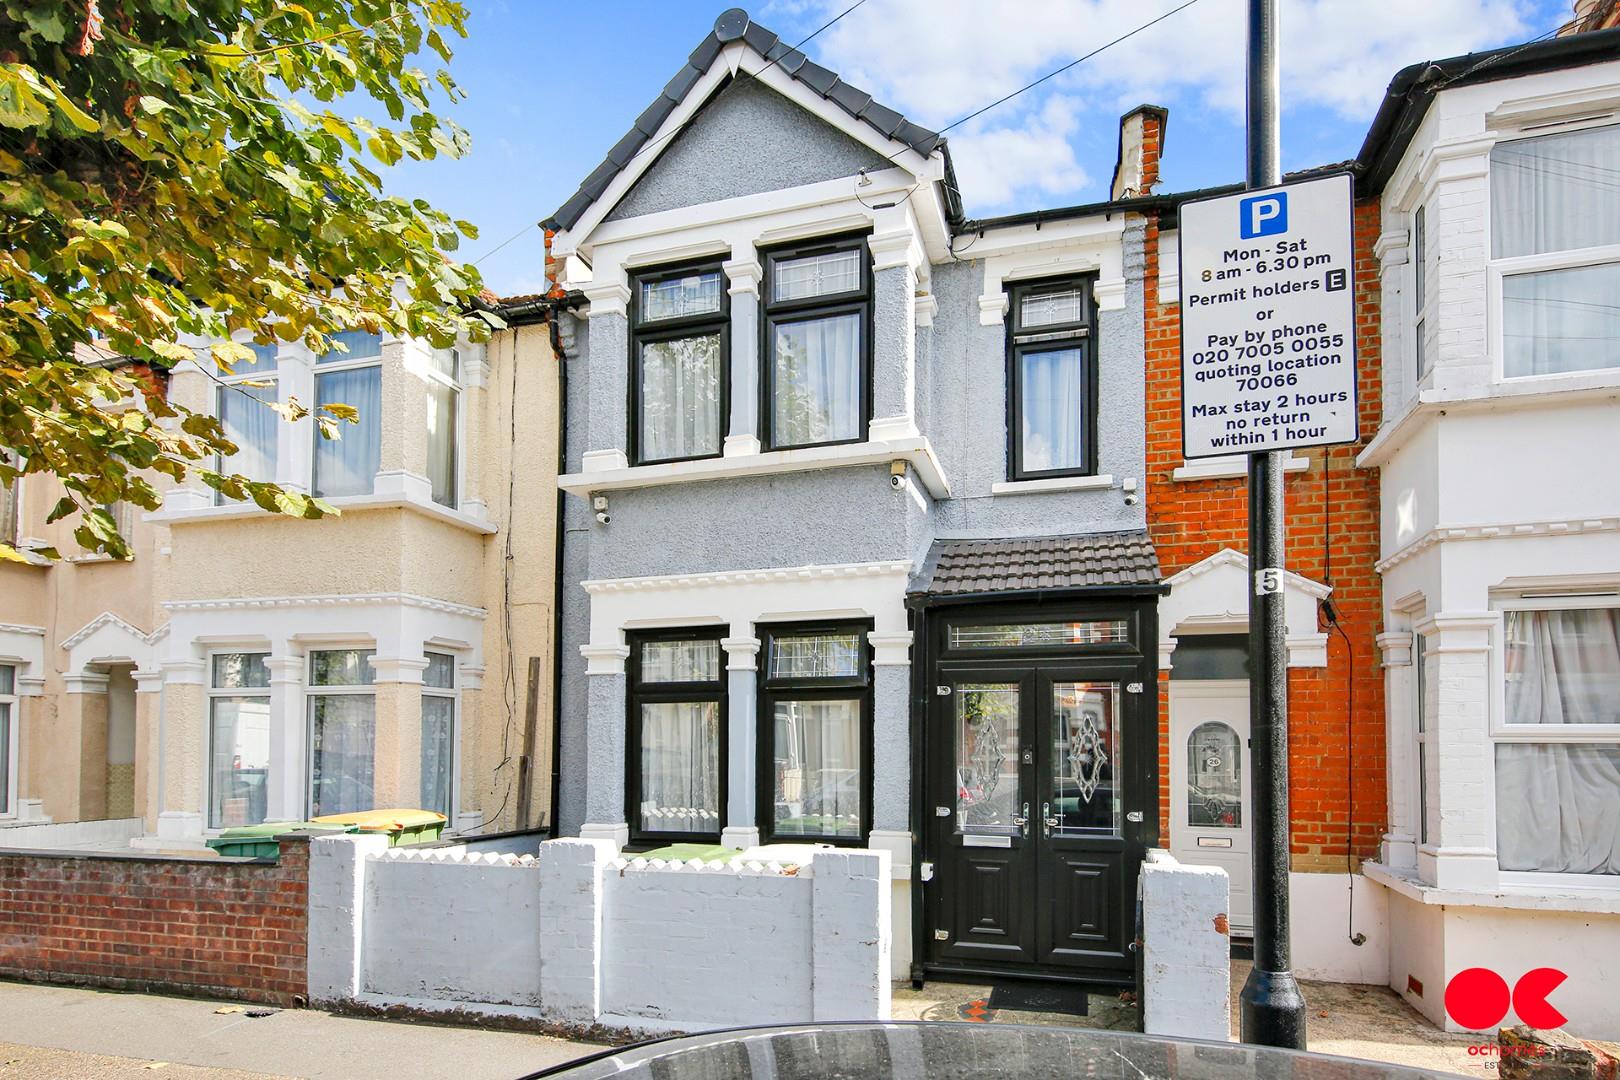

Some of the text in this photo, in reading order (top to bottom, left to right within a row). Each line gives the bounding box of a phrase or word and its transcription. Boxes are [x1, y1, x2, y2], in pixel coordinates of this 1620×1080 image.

[1251, 198, 1281, 234] P
[1223, 247, 1261, 263] Mon
[1276, 238, 1308, 255] Sat
[1201, 269, 1212, 282] 8
[1216, 267, 1242, 280] am
[1256, 256, 1299, 274] 6.30
[1303, 253, 1331, 269] pm
[1189, 272, 1343, 308] Permit holders E
[1256, 309, 1274, 321] or
[1207, 322, 1328, 348] Pay by phone
[1192, 334, 1344, 365] 020 7005 0055
[1195, 353, 1341, 383] quoting location
[1236, 373, 1298, 392] 70066
[1192, 391, 1348, 418] Max stay 2 hours
[1226, 412, 1310, 430] no return
[1210, 426, 1327, 448] within 1 hour
[1262, 571, 1279, 592] 5
